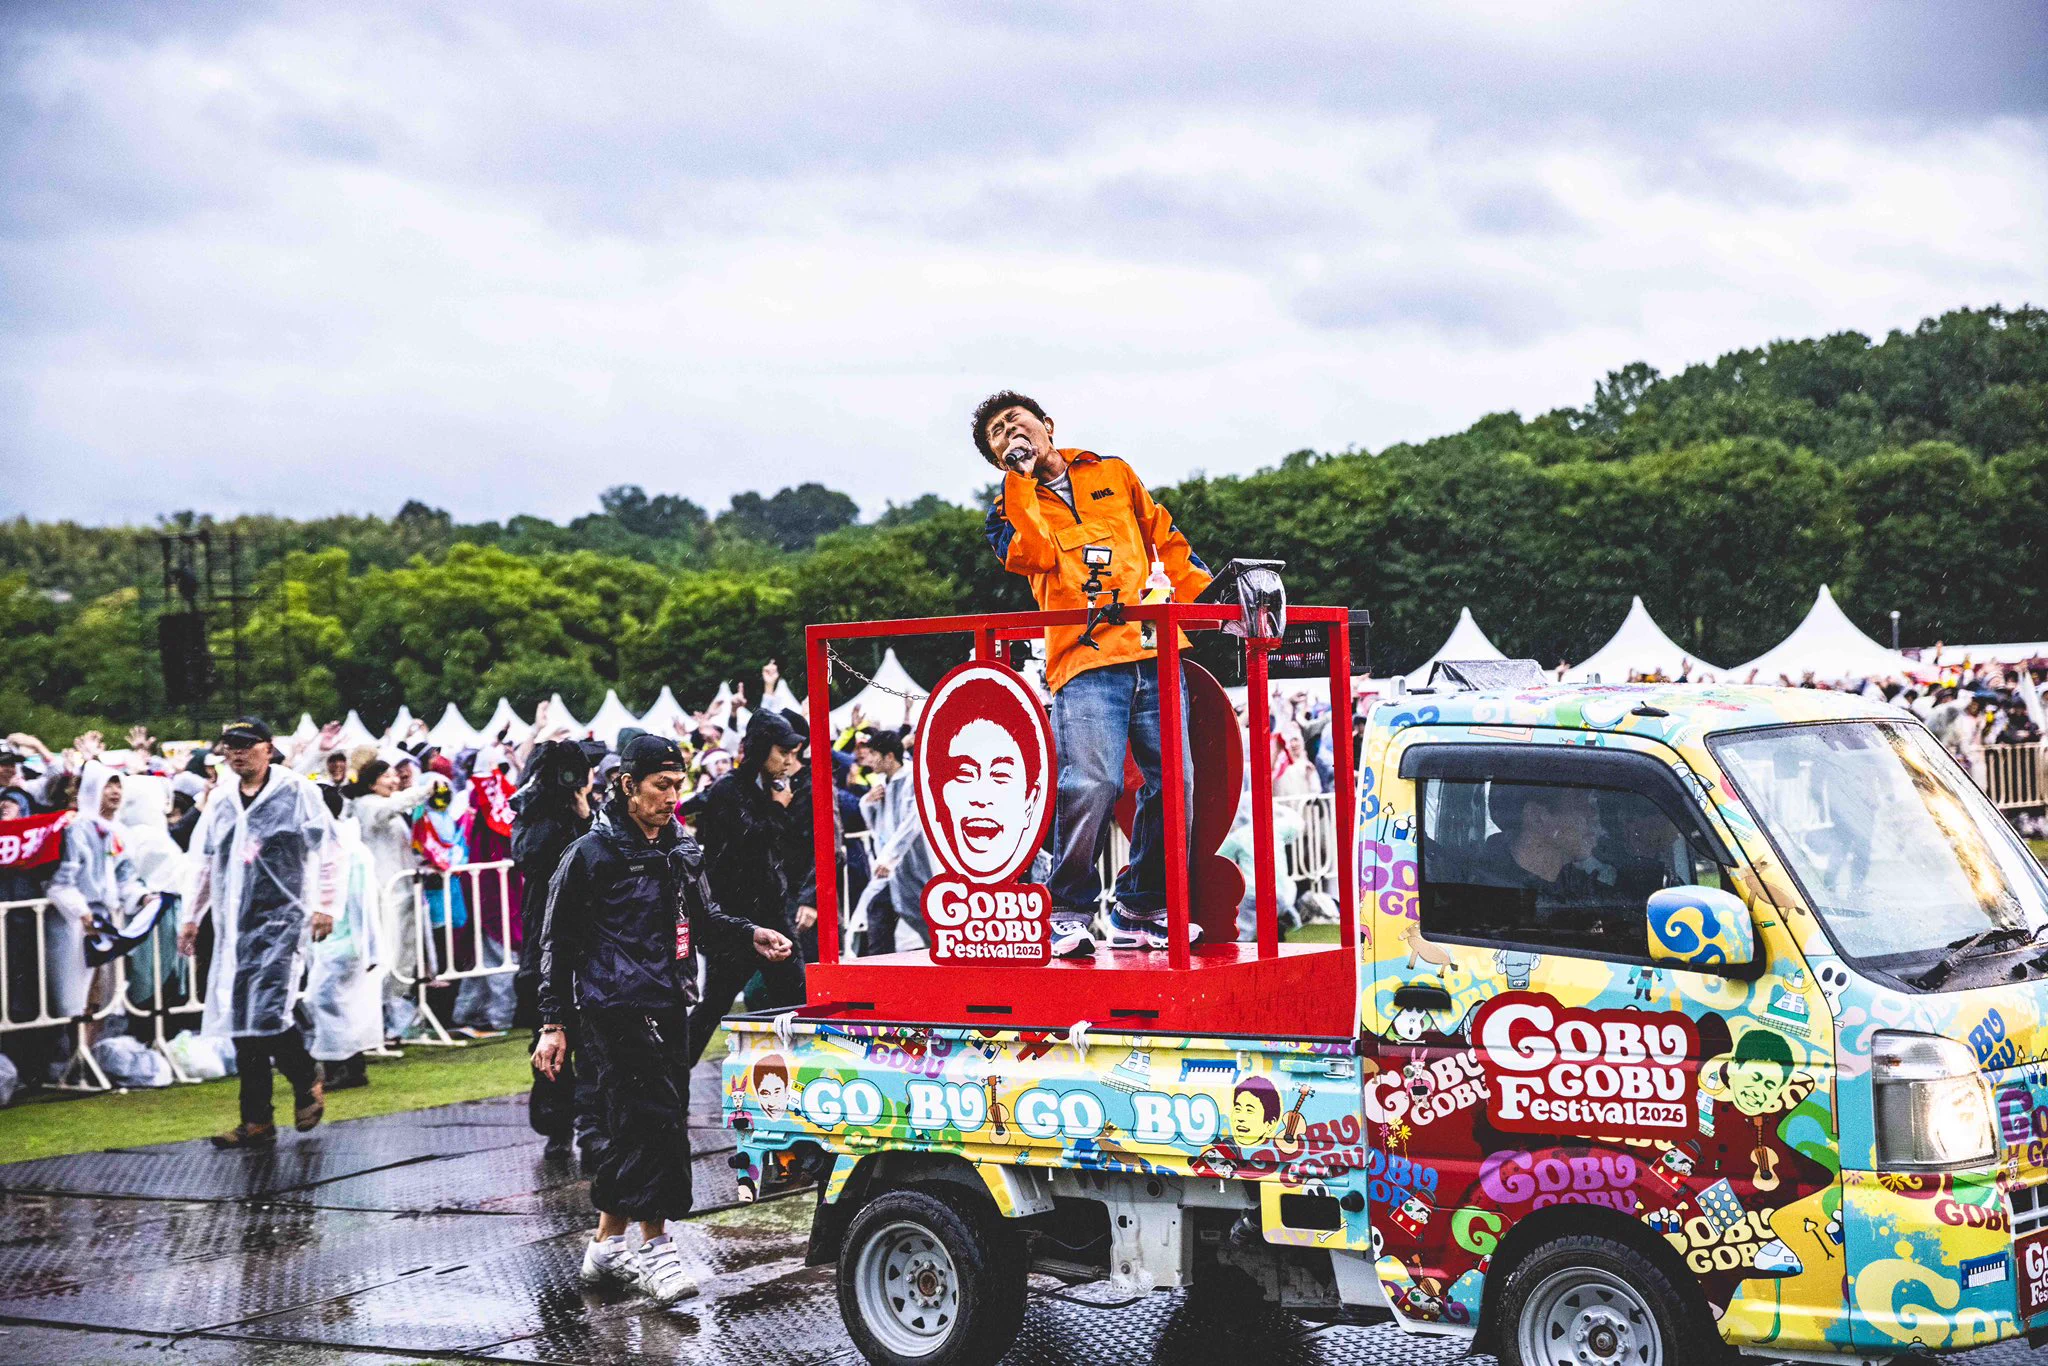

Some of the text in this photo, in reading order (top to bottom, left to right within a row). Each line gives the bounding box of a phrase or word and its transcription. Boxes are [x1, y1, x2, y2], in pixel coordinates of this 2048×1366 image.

[927, 882, 1043, 926] GOBU
[935, 929, 1040, 958] Festival 2026
[965, 920, 1042, 941] GOBU
[1482, 1004, 1687, 1071] GOBU
[1496, 1075, 1684, 1125] Festival 2026
[1548, 1063, 1686, 1101] GOBU
[1479, 1150, 1636, 1204] GOBU
